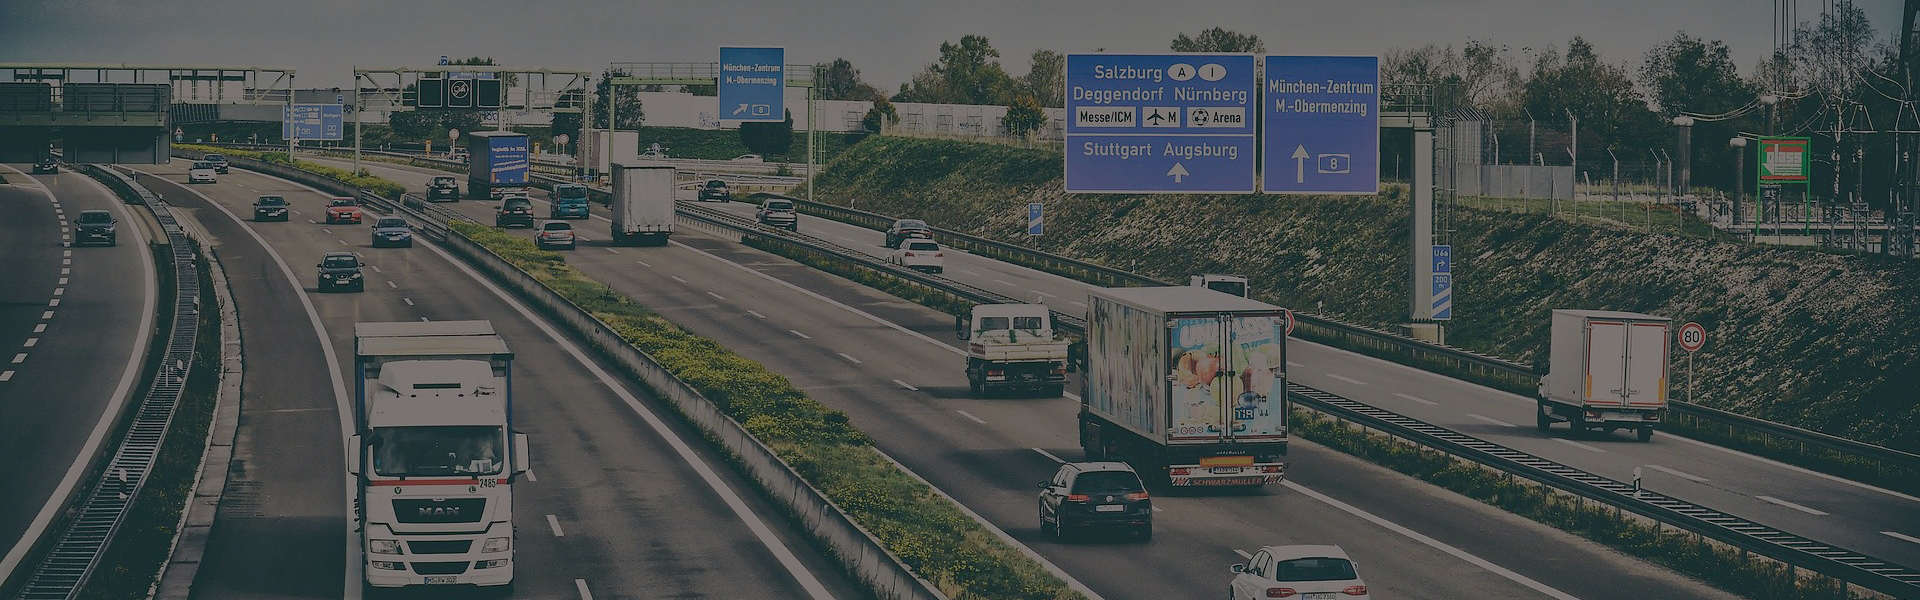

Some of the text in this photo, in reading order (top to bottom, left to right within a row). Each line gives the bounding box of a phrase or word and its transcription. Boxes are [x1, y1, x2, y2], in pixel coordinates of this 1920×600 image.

[723, 63, 781, 72] München-Zentrum
[1094, 65, 1162, 83] Salzburg
[1177, 67, 1186, 78] A
[726, 76, 777, 86] M.-Obermenzing
[1269, 78, 1374, 94] München-Zentrum
[1073, 86, 1247, 105] Deggendorf Nürnberg
[758, 106, 764, 114] 8
[1275, 98, 1367, 117] M.-Obermenzing
[1080, 111, 1132, 124] Messe/ICM
[1168, 111, 1176, 124] M
[1213, 111, 1241, 124] Arena
[1083, 142, 1238, 160] Stuttgart Augsburg
[1330, 157, 1338, 170] 8
[1685, 331, 1699, 343] 80
[1236, 409, 1254, 419] TIR
[479, 479, 496, 488] 2485
[418, 506, 460, 516] MAN
